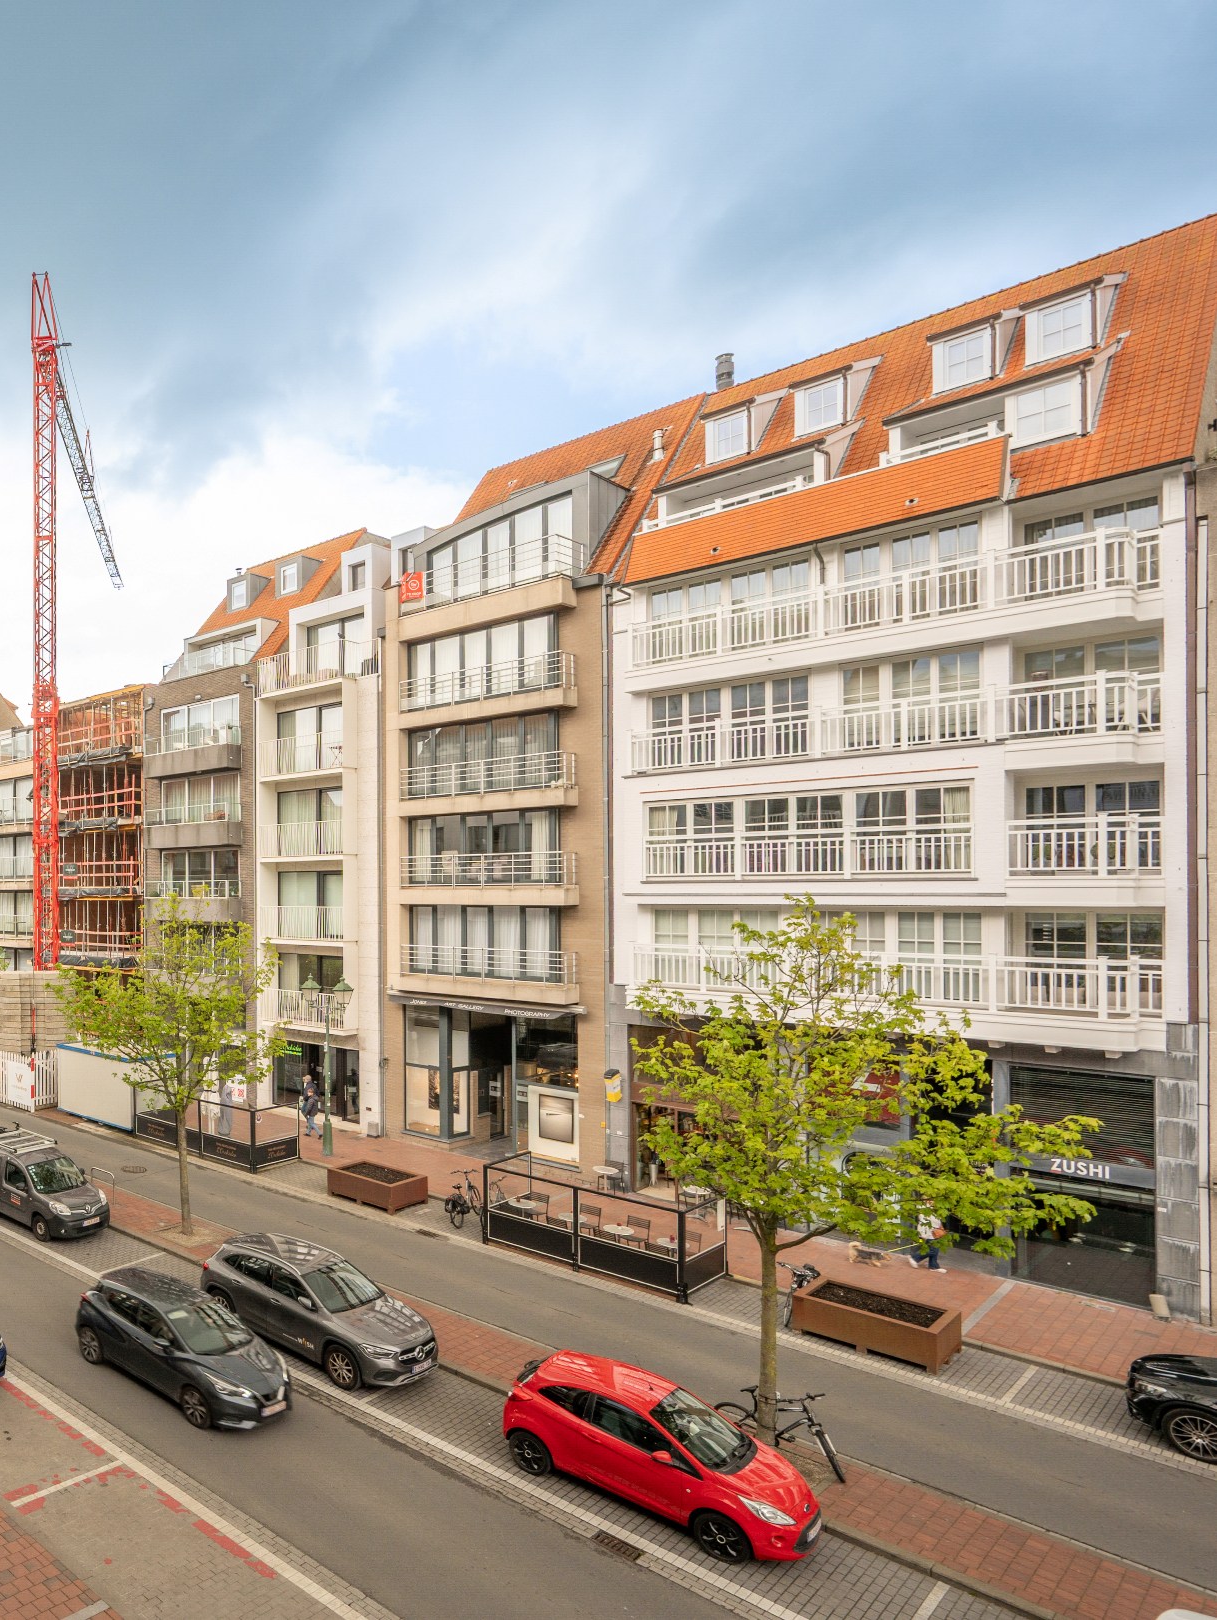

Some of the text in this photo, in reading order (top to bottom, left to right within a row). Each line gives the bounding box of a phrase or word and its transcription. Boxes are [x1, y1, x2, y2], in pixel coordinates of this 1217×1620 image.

[458, 1003, 484, 1011] GALLERY
[504, 1008, 550, 1018] PHOTOGRAPHY
[1050, 1158, 1110, 1179] ZUSHI
